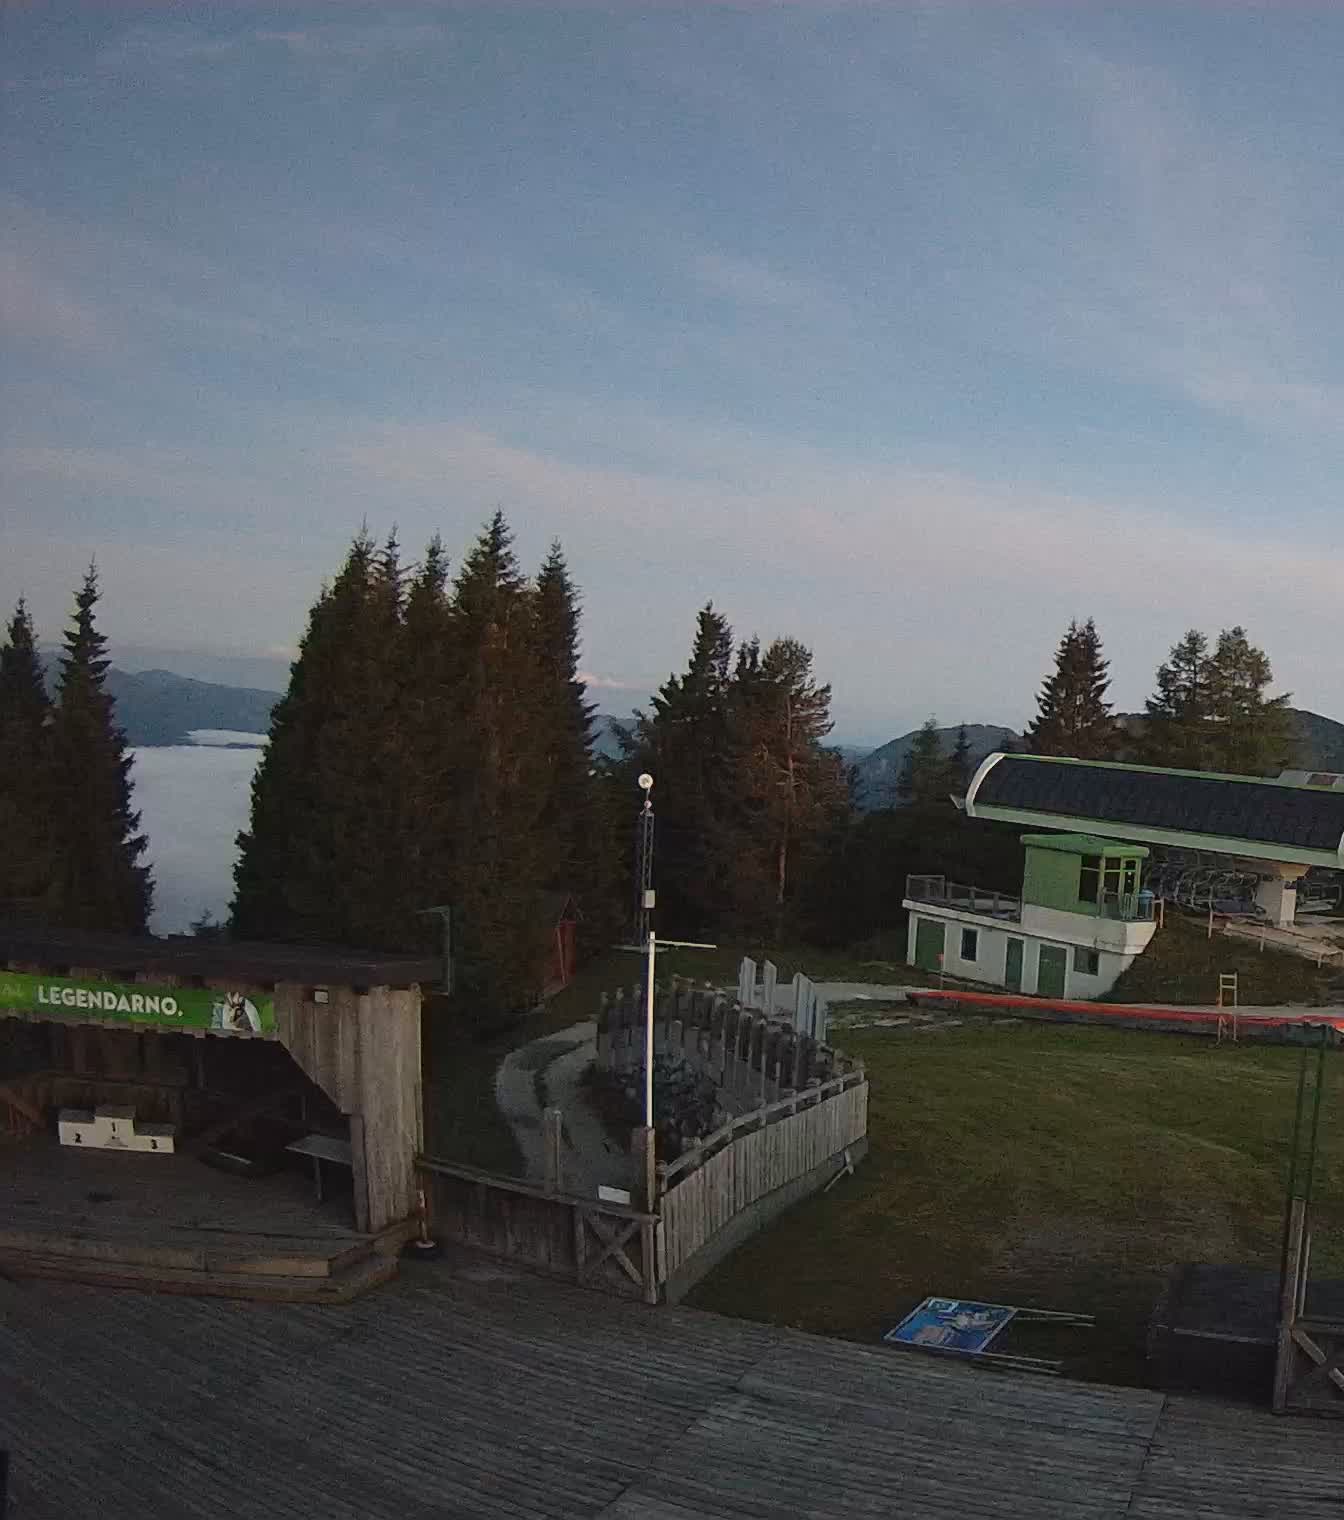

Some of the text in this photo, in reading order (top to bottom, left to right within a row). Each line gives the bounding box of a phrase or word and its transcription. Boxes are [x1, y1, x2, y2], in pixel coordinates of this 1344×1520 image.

[37, 984, 184, 1017] LEGENDARNO.
[74, 1133, 82, 1144] 2
[151, 1139, 158, 1150] 3
